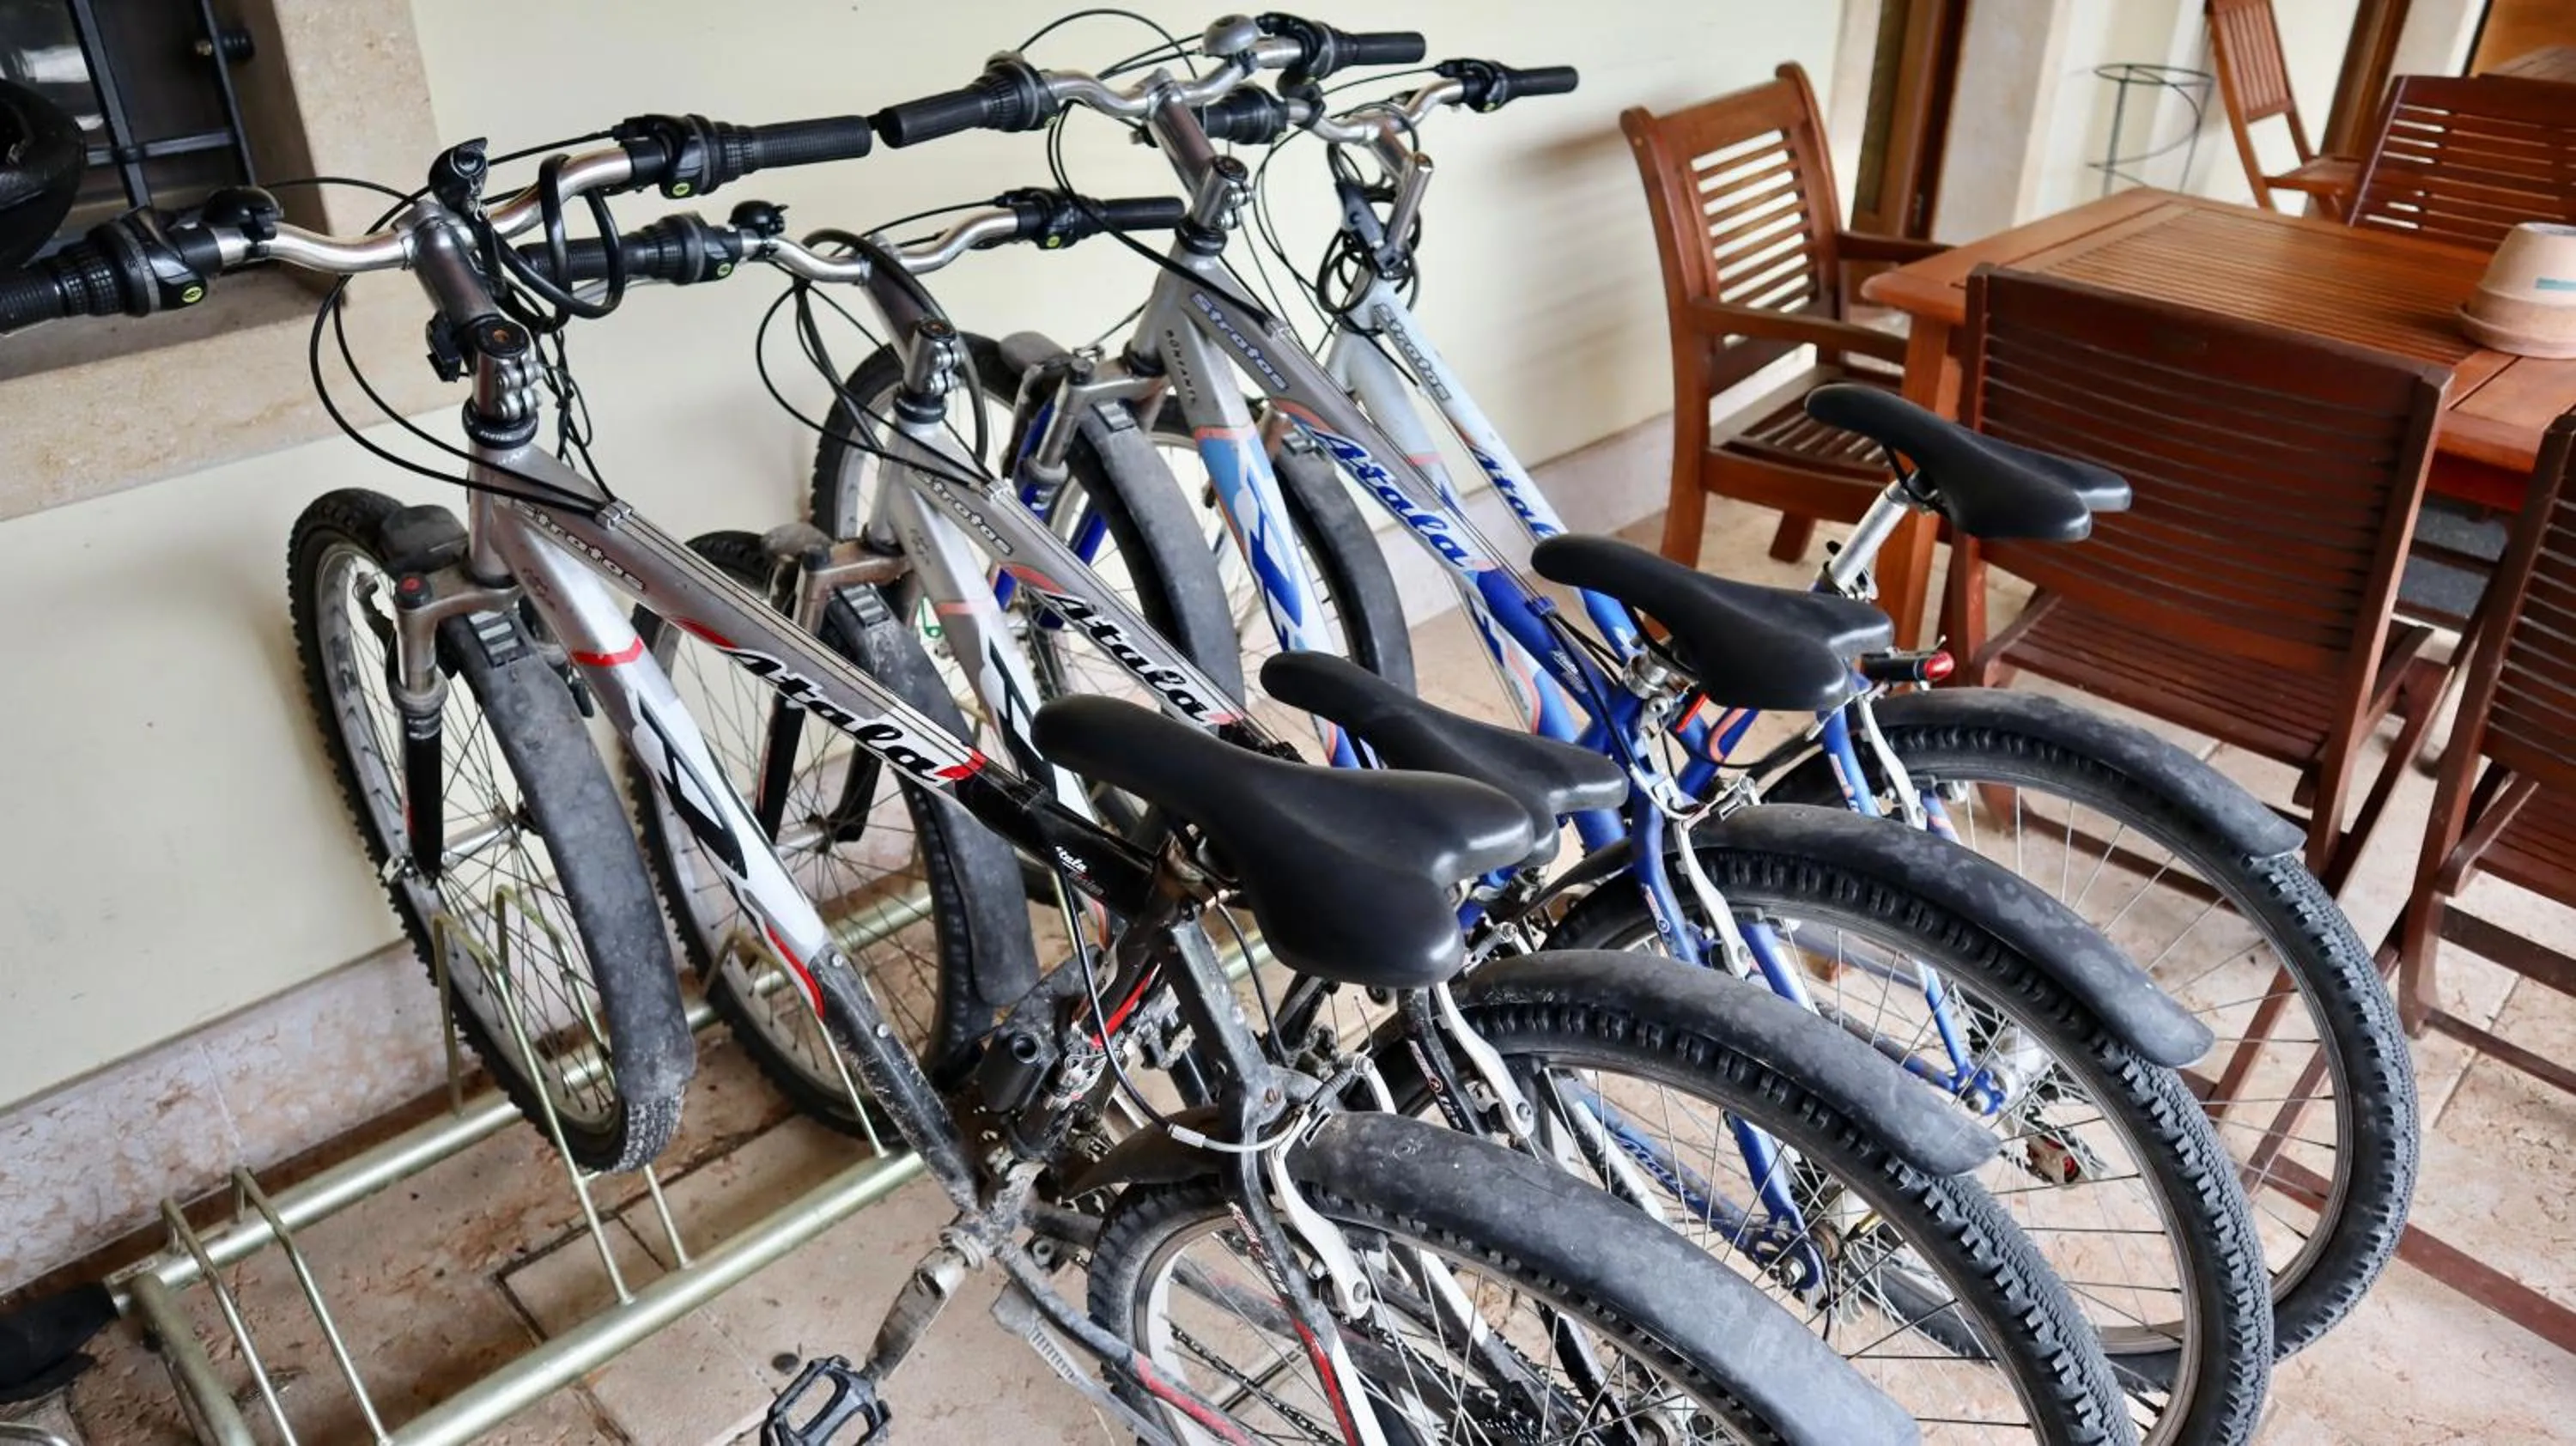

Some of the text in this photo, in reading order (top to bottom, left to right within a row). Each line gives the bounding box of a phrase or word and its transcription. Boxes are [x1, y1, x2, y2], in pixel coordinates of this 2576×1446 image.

[1311, 430, 1469, 568] Atala
[1468, 446, 1559, 539] Atal
[716, 646, 939, 783] Atala
[1042, 592, 1209, 723] Atala
